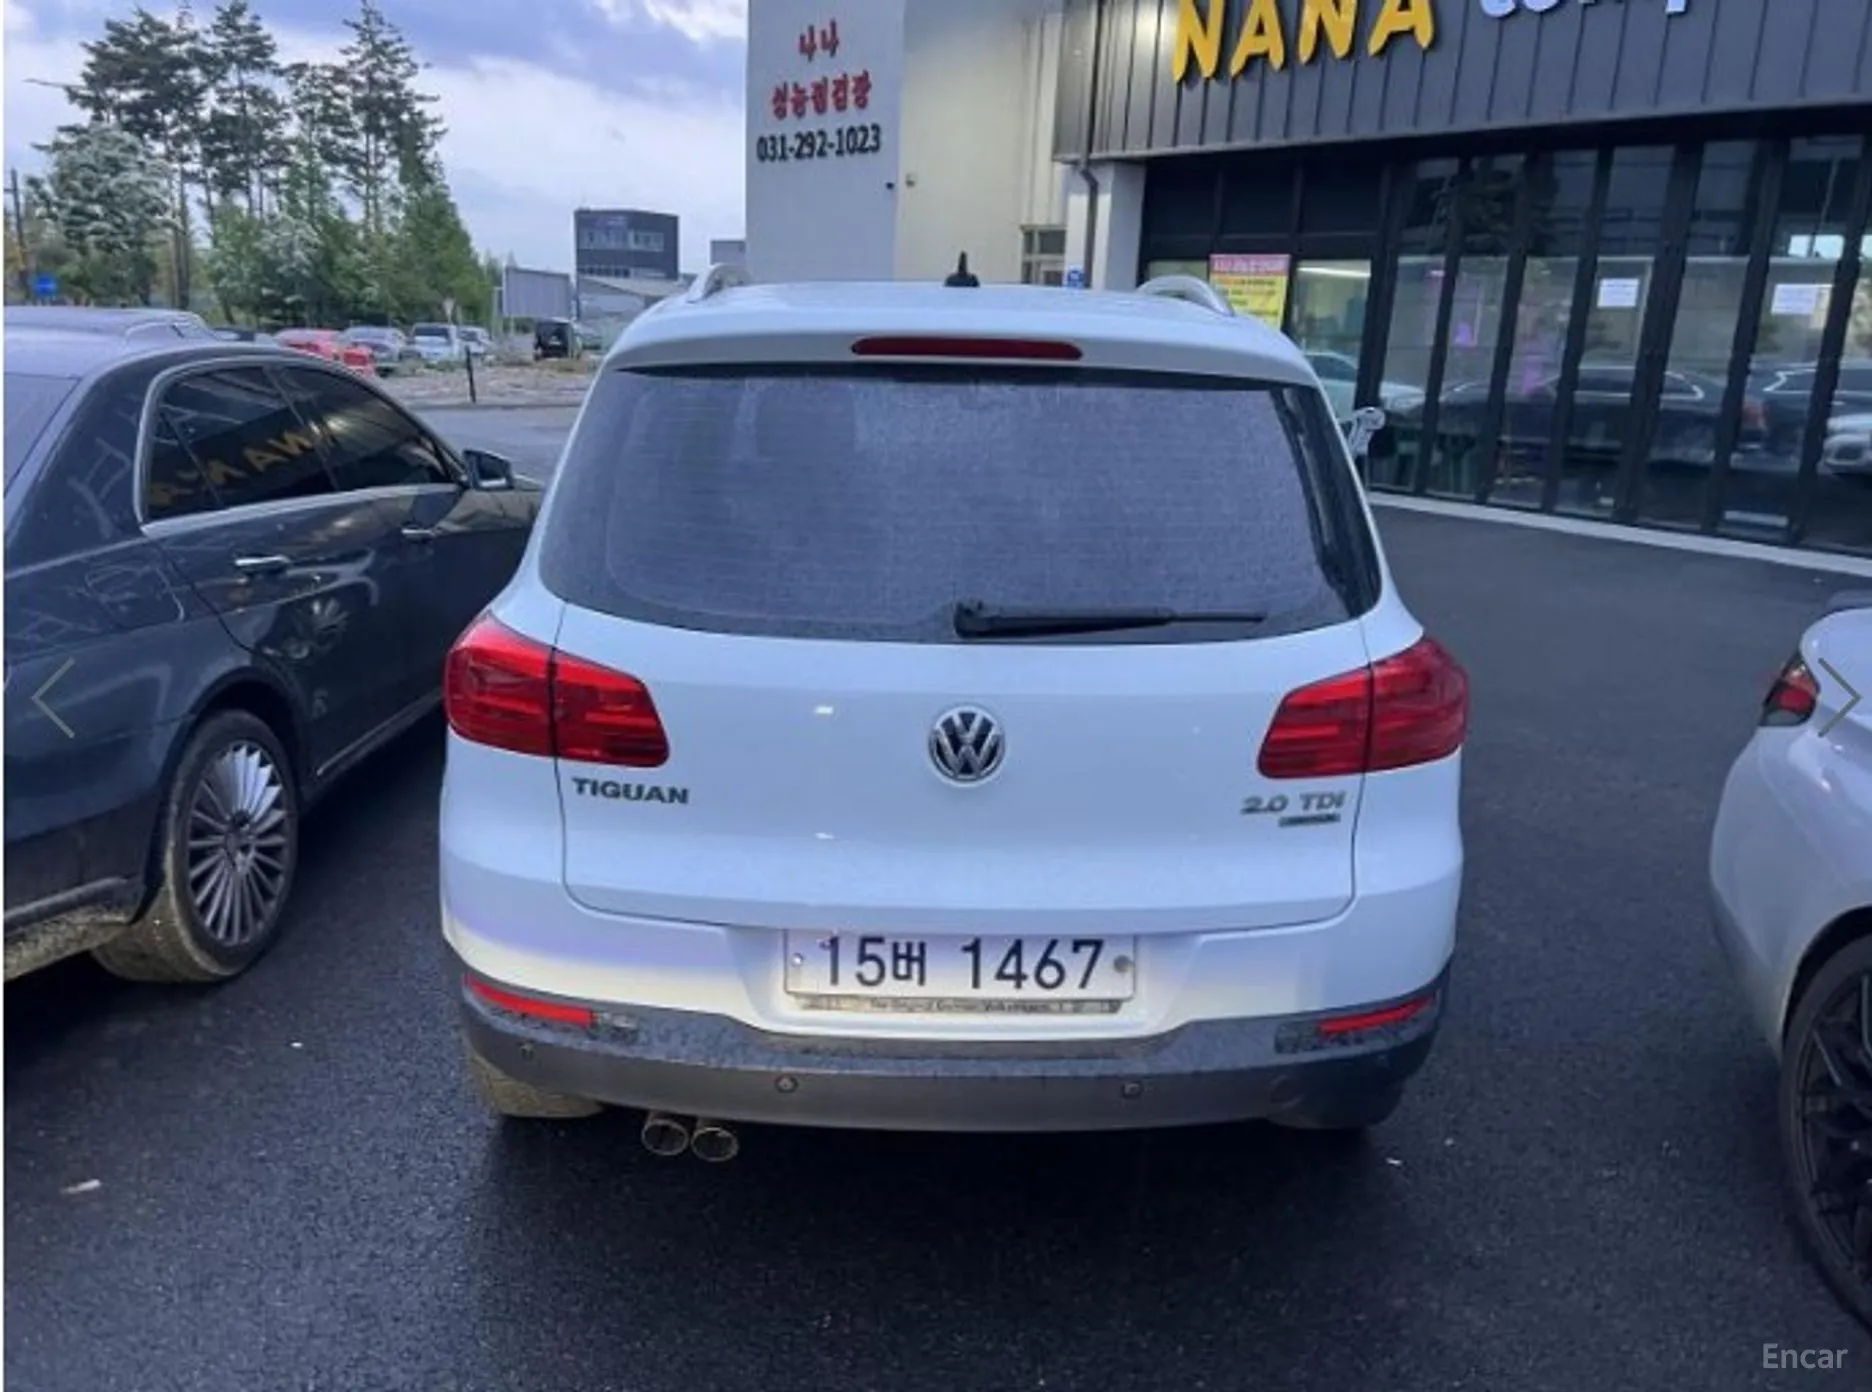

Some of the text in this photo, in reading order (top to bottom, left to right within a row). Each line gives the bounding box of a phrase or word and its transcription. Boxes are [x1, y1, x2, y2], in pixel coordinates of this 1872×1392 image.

[798, 18, 840, 62] 나나
[1171, 0, 1435, 83] NANA
[755, 122, 882, 163] 031-292-1023
[572, 777, 689, 804] TIGUAN
[819, 935, 1105, 990] 15버 1467
